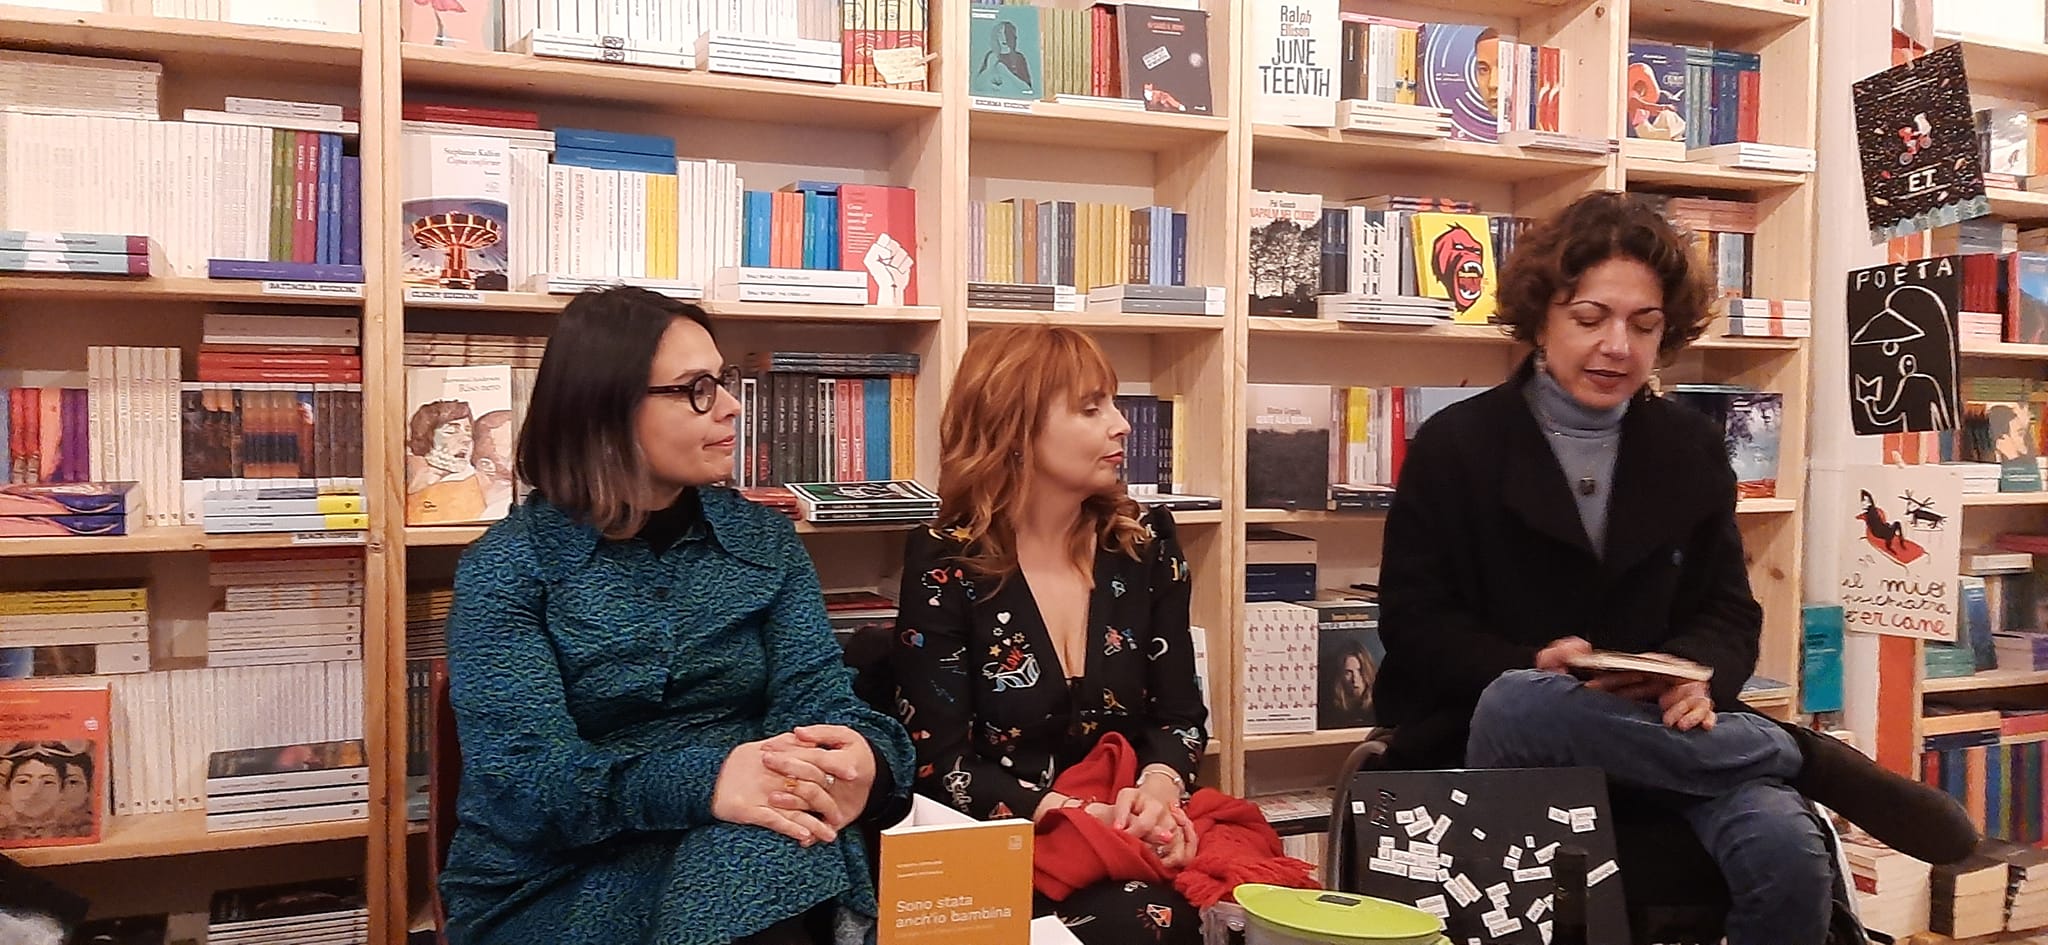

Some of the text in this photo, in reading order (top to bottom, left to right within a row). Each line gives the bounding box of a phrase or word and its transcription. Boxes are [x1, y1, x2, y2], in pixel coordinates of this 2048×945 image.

[1280, 5, 1312, 25] Ralph
[1271, 37, 1316, 66] JUNE
[1258, 65, 1330, 97] TEENTH
[1855, 257, 1954, 291] POETA
[1841, 572, 1946, 598] il mio
[1891, 613, 1951, 636] cane
[896, 895, 974, 913] Sono stata
[950, 906, 1012, 922] bambina
